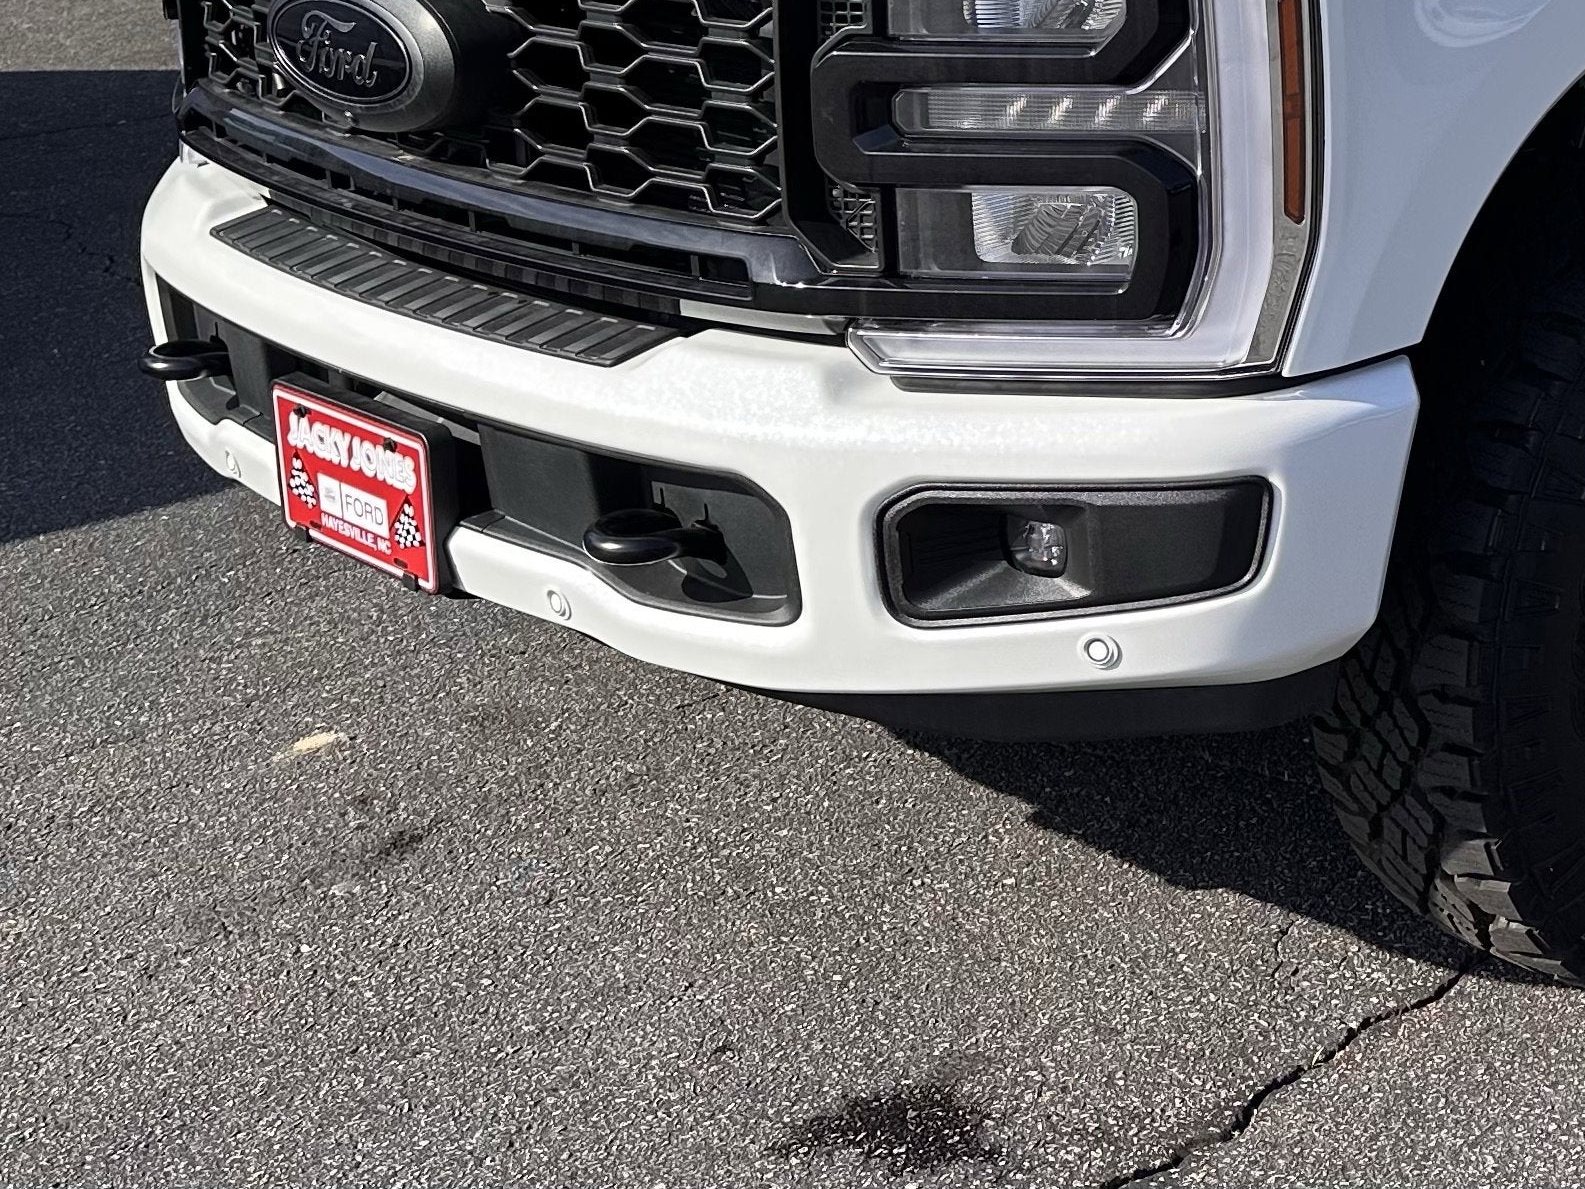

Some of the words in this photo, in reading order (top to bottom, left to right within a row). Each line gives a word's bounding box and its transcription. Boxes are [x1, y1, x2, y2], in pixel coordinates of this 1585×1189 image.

[296, 9, 378, 88] Ford
[288, 412, 350, 467] JACKY
[351, 439, 416, 493] JONES
[345, 494, 383, 525] FORD
